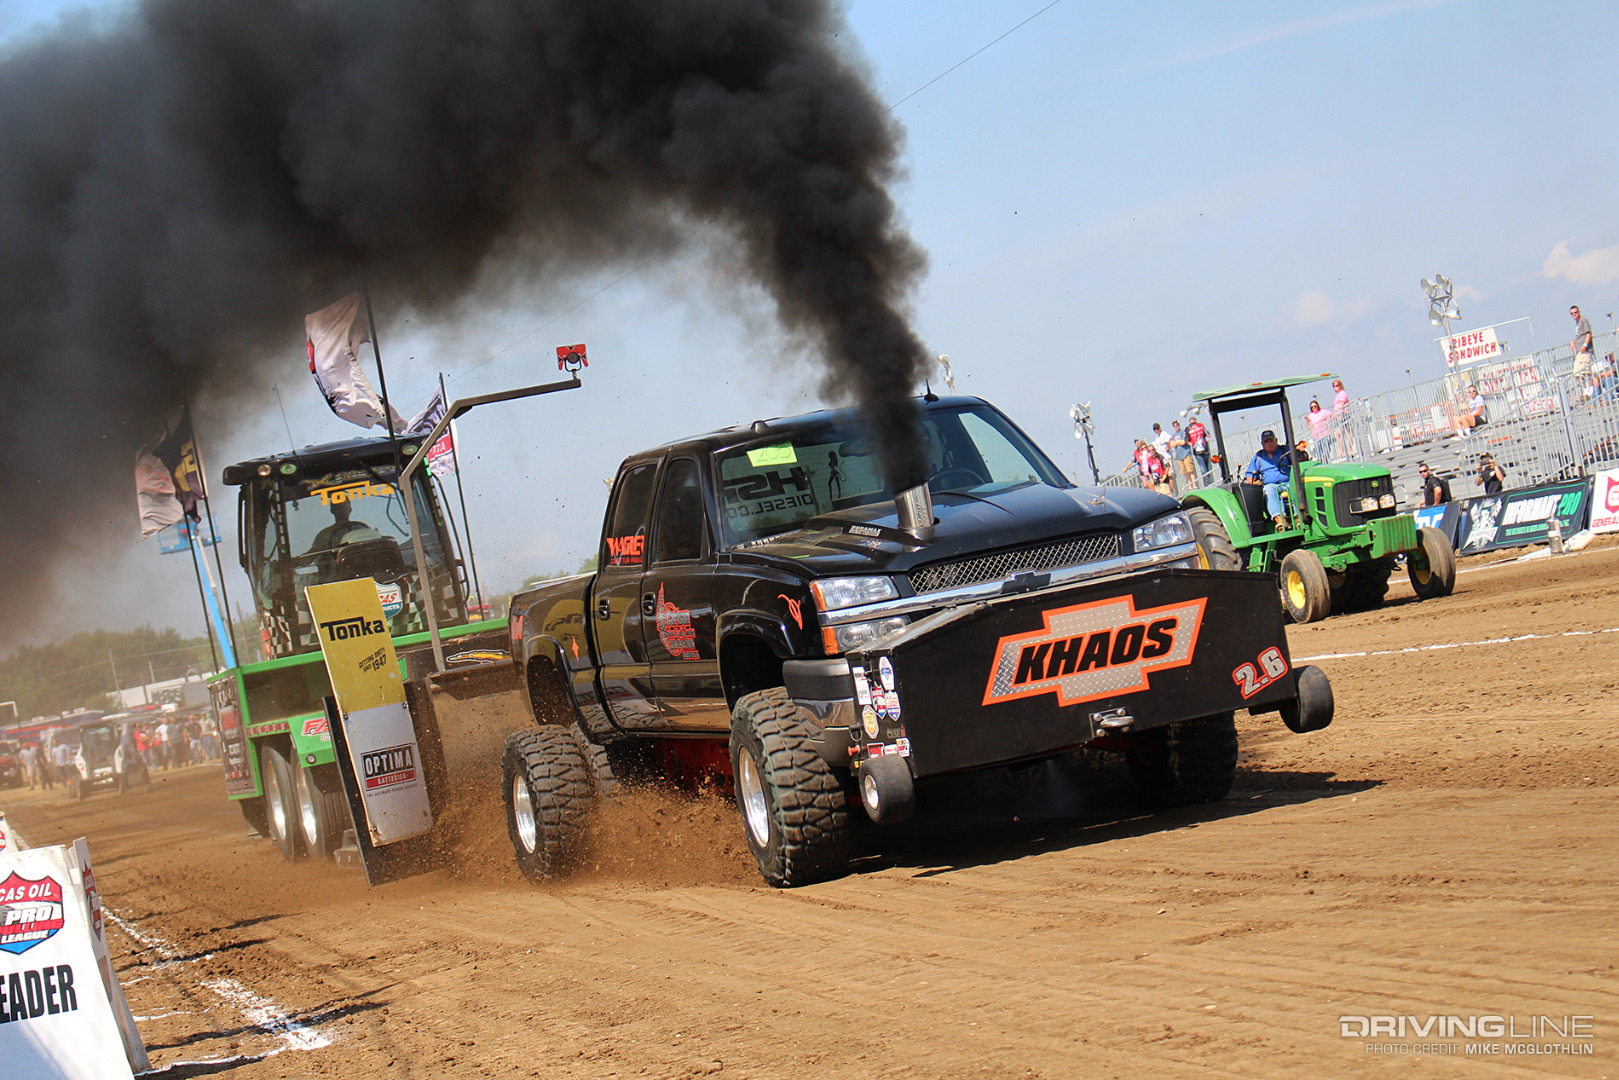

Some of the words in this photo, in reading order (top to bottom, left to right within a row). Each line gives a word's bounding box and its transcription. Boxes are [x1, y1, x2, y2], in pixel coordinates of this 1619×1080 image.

[1451, 331, 1484, 348] RIBEYE
[310, 480, 395, 506] Tonka
[320, 616, 386, 642] Tonka
[1013, 616, 1178, 686] KHAOS
[372, 653, 387, 671] 1947
[1233, 647, 1287, 698] 2.6
[365, 749, 412, 775] OPTIMA
[377, 772, 407, 784] BATTERIES
[28, 882, 53, 899] OIL
[4, 905, 53, 926] PRO
[1, 930, 49, 944] LEAGUE
